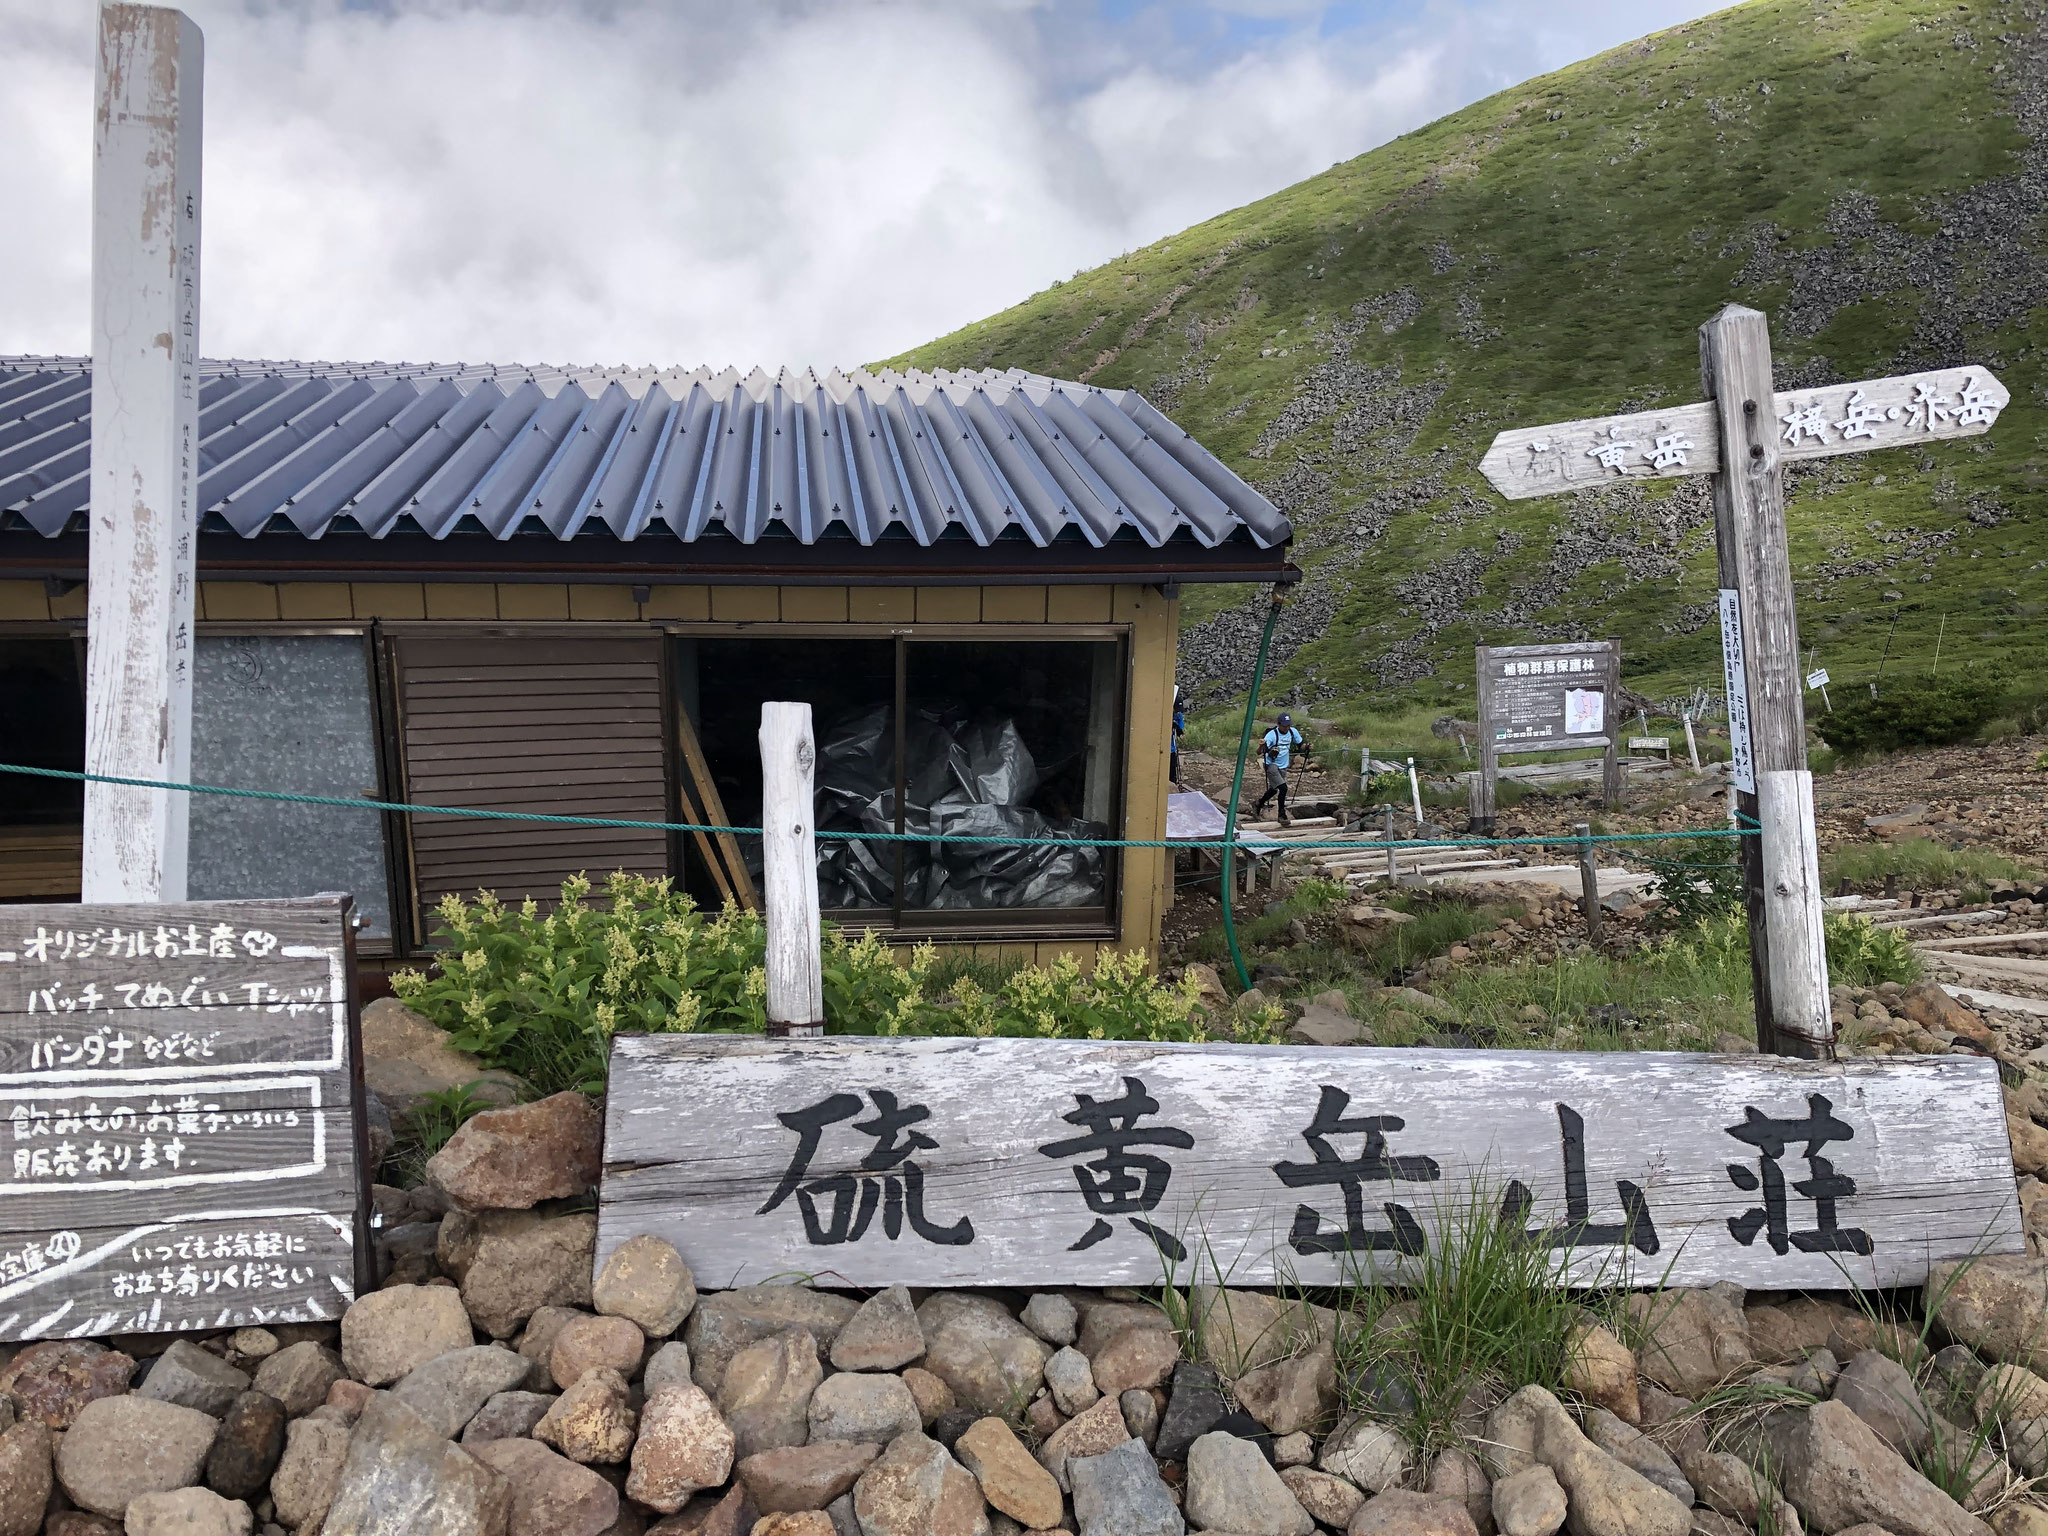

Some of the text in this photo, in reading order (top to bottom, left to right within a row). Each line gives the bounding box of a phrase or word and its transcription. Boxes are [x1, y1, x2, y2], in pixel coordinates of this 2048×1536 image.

[1503, 657, 1595, 676] 植物群落保護林
[22, 922, 237, 963] オリジナルお土産
[756, 1076, 1876, 1263] 硫黄岳山荘
[131, 1230, 307, 1263] いつでもお気軽に
[111, 1262, 314, 1298] お立ち寄りください
